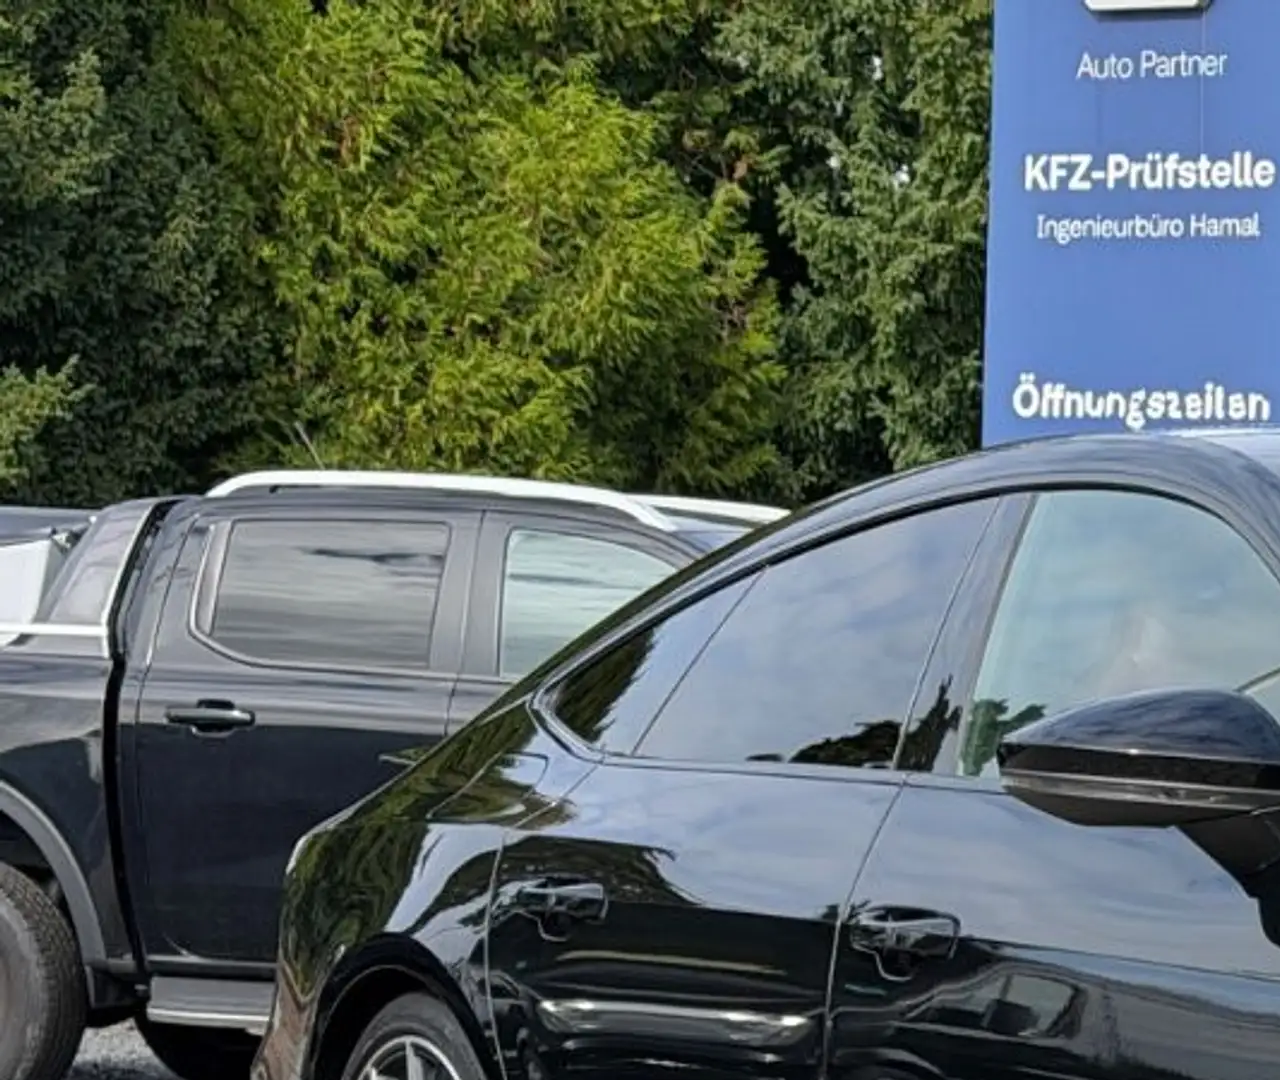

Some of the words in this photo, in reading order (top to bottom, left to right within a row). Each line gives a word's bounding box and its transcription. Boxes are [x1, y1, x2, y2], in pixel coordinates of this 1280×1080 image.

[1075, 51, 1134, 80] Auto
[1139, 49, 1229, 79] Partner
[1024, 150, 1276, 192] KFZ-Prüfstelle
[1036, 212, 1185, 245] Ingenieurbüro
